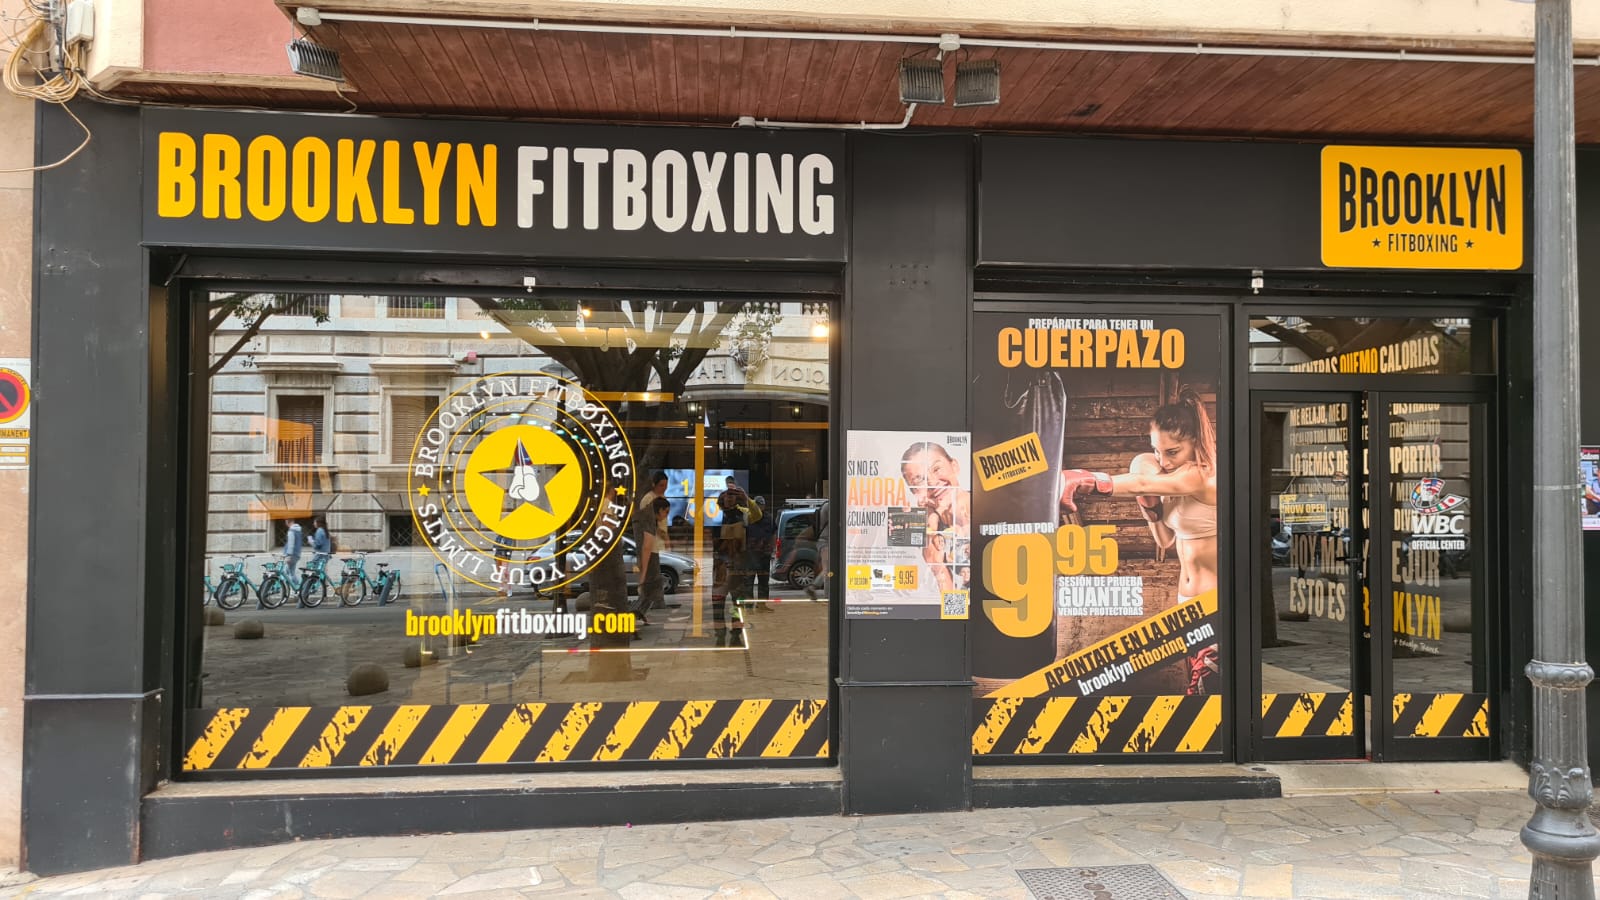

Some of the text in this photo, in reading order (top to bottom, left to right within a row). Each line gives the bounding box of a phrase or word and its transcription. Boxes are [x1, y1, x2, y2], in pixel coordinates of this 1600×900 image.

[157, 132, 834, 235] BROOKLYN FITBOXING
[1339, 161, 1506, 235] BROOKLYN
[1388, 233, 1458, 253] FITBOXING
[1028, 317, 1154, 330] PREPÁRATE PARA TENER UN
[997, 327, 1185, 369] CUERPAZO
[1340, 348, 1378, 373] QUEMO
[1380, 335, 1440, 373] CALORIAS
[415, 377, 630, 479] BROOKLYN FITBOXING
[848, 460, 879, 476] SI NO ES
[979, 438, 1041, 479] BROOKLYN
[1390, 445, 1440, 474] PORTAR
[847, 508, 885, 527] ¿CUÁNDO?
[1285, 503, 1326, 514] NOW OPEN
[1412, 514, 1465, 534] WBC
[1033, 522, 1055, 534] POR
[418, 502, 627, 587] FIGHT YOUR LIMITS
[1411, 540, 1466, 551] OFFICIAL CENTER
[1290, 534, 1316, 572] HOY
[1391, 540, 1441, 588] EJOR
[899, 571, 915, 586] 9,95
[984, 524, 1119, 638] 9 95
[1058, 574, 1143, 587] SESIÓN DE PRUEBA
[1058, 586, 1144, 607] GUANTES
[1058, 607, 1144, 616] VENDAS PROTECTORAS
[1289, 576, 1324, 618] ESTO
[1328, 582, 1346, 622] ES
[406, 607, 635, 642] brooklynfitboxing.com
[1044, 601, 1206, 689] APÚNTATE EN LA WEB!
[1077, 622, 1215, 697] brooklynfitboxing.com
